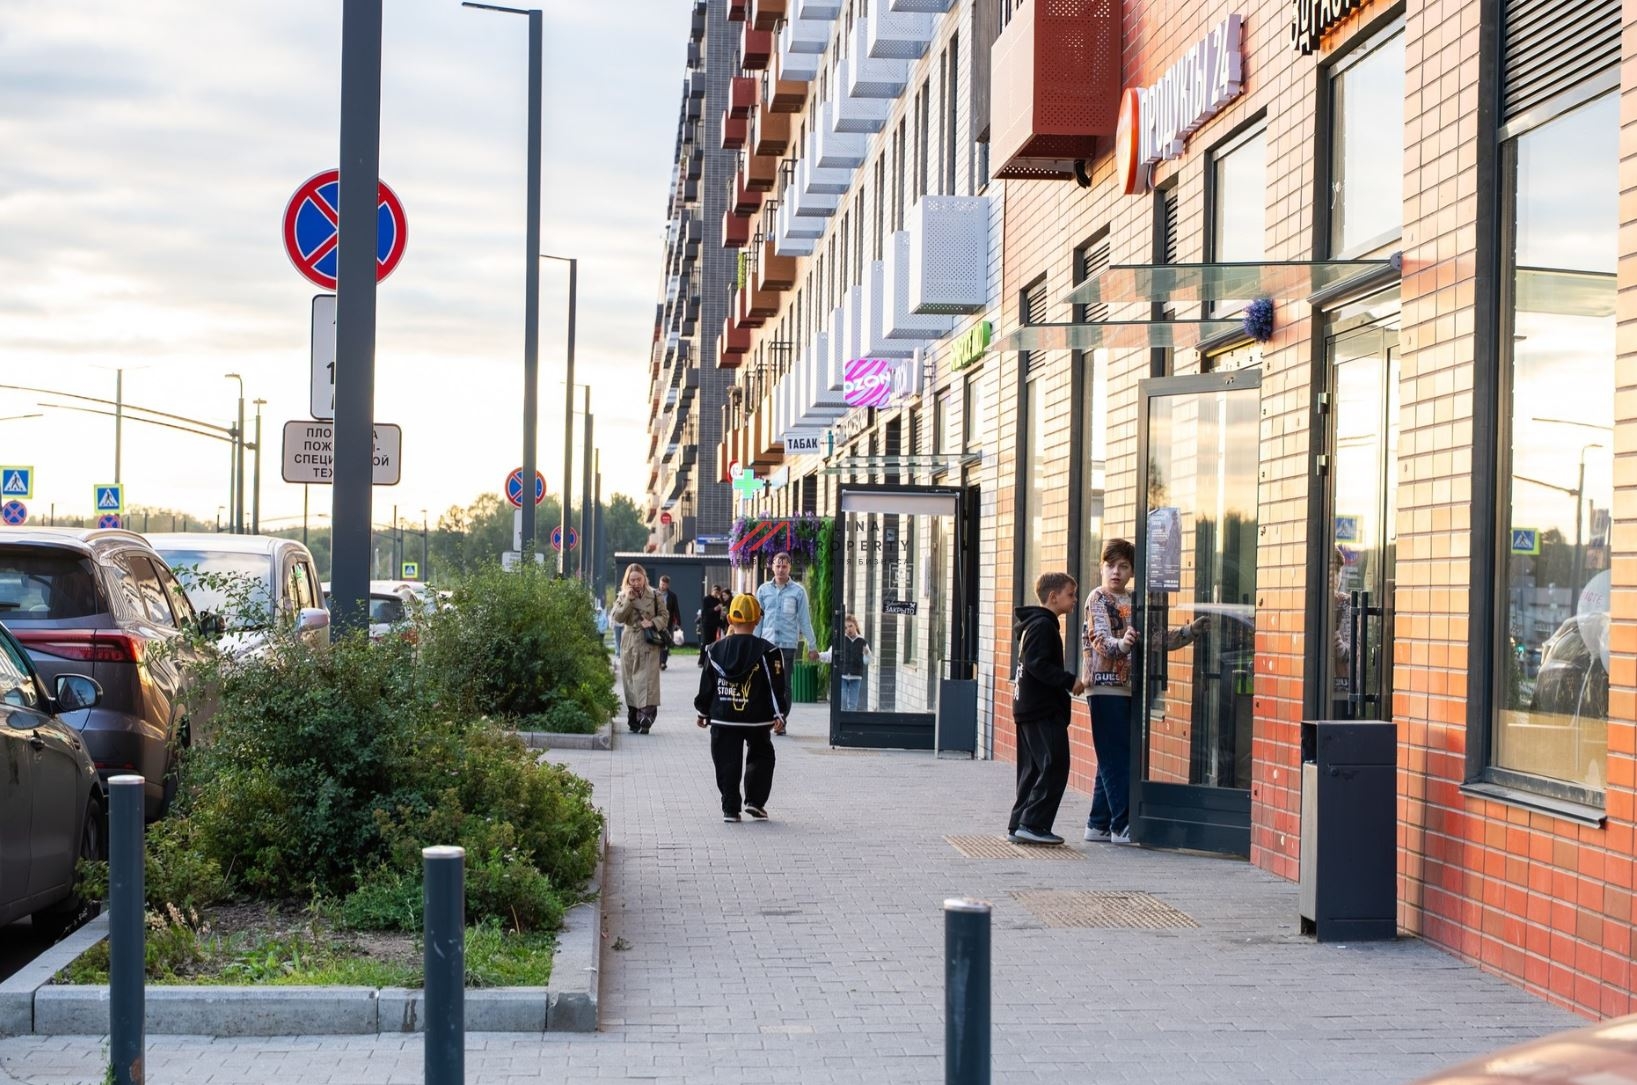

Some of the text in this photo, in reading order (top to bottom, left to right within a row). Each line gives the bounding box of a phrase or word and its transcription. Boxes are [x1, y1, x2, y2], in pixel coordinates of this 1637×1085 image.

[1140, 13, 1234, 165] ПРОДУКТЫ 24
[844, 371, 890, 394] OZON
[787, 437, 818, 449] ТАБАК
